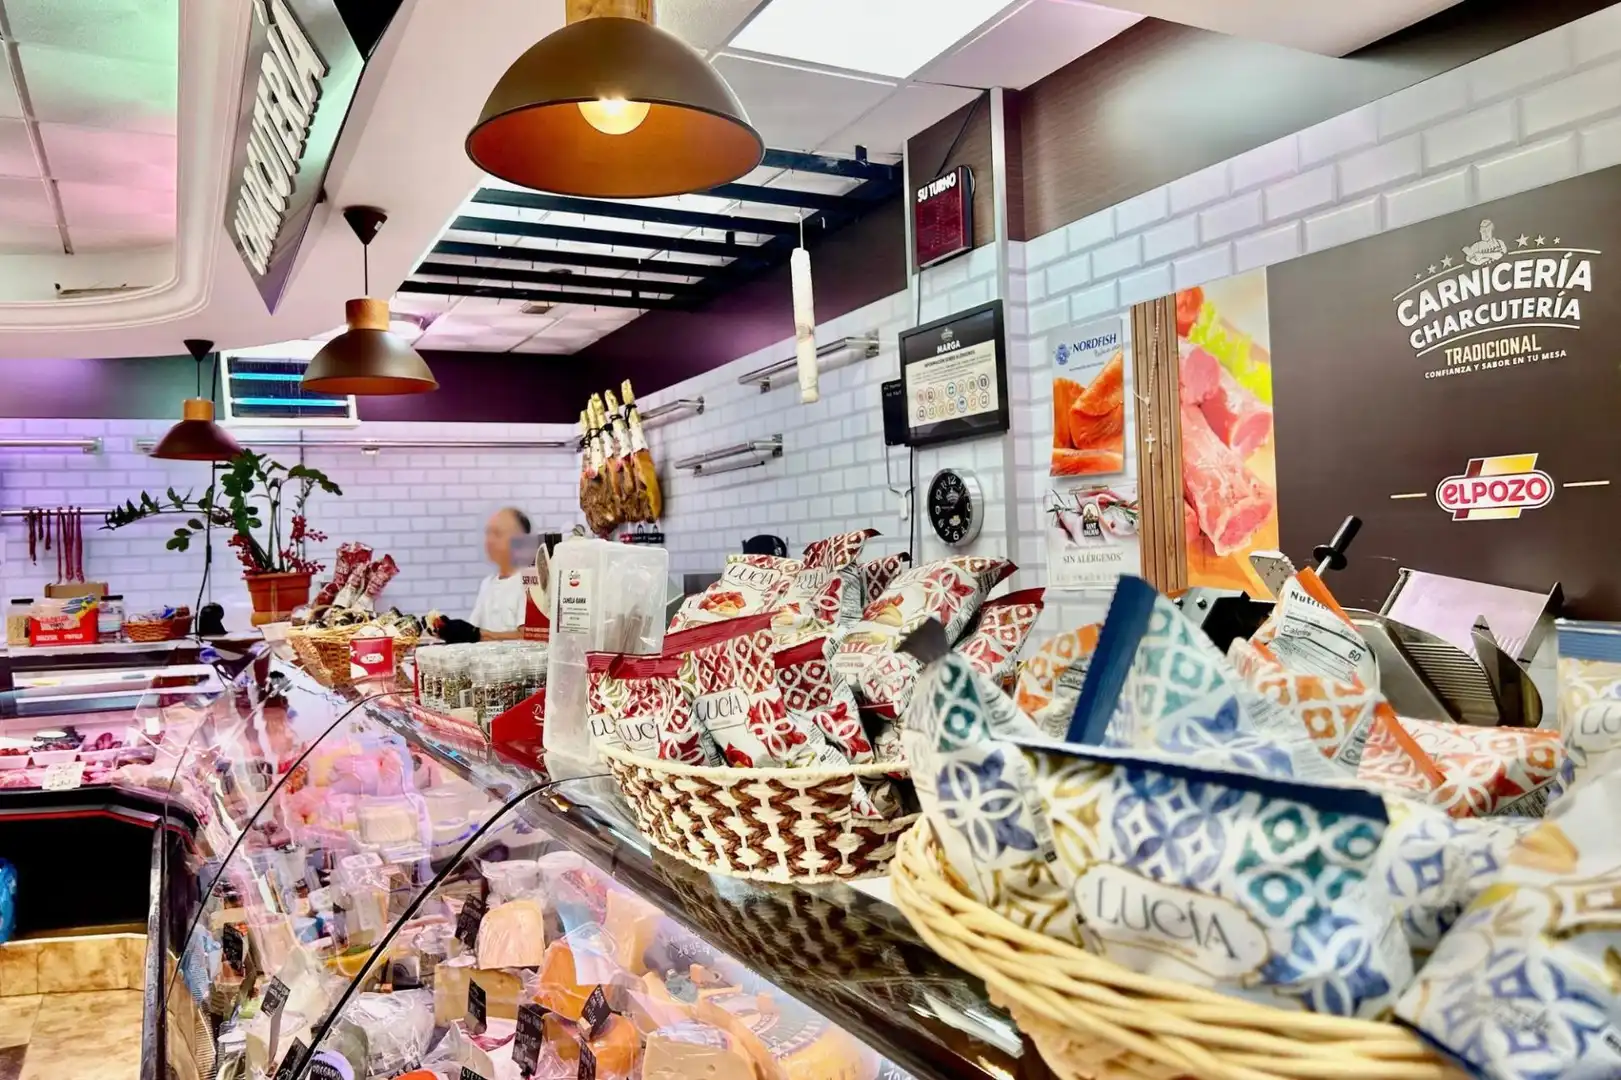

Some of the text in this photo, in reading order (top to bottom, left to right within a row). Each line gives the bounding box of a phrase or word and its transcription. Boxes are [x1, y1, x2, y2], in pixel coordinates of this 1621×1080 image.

[917, 172, 957, 203] SU TURNO
[1397, 252, 1593, 327] CARNICERÍA
[1409, 291, 1581, 349] CHARCUTERÍA
[937, 340, 961, 353] MARGA
[1073, 333, 1117, 353] NORDFISH
[1444, 334, 1541, 366] TRADICIONAL
[1424, 365, 1471, 379] CONFIANZA
[1481, 359, 1510, 370] SABOR
[1512, 356, 1525, 365] EN
[1526, 354, 1539, 363] TU
[1541, 349, 1567, 361] MESA
[947, 475, 957, 485] 12
[952, 531, 960, 541] 6
[1063, 555, 1075, 564] SIN
[1348, 649, 1362, 662] 60
